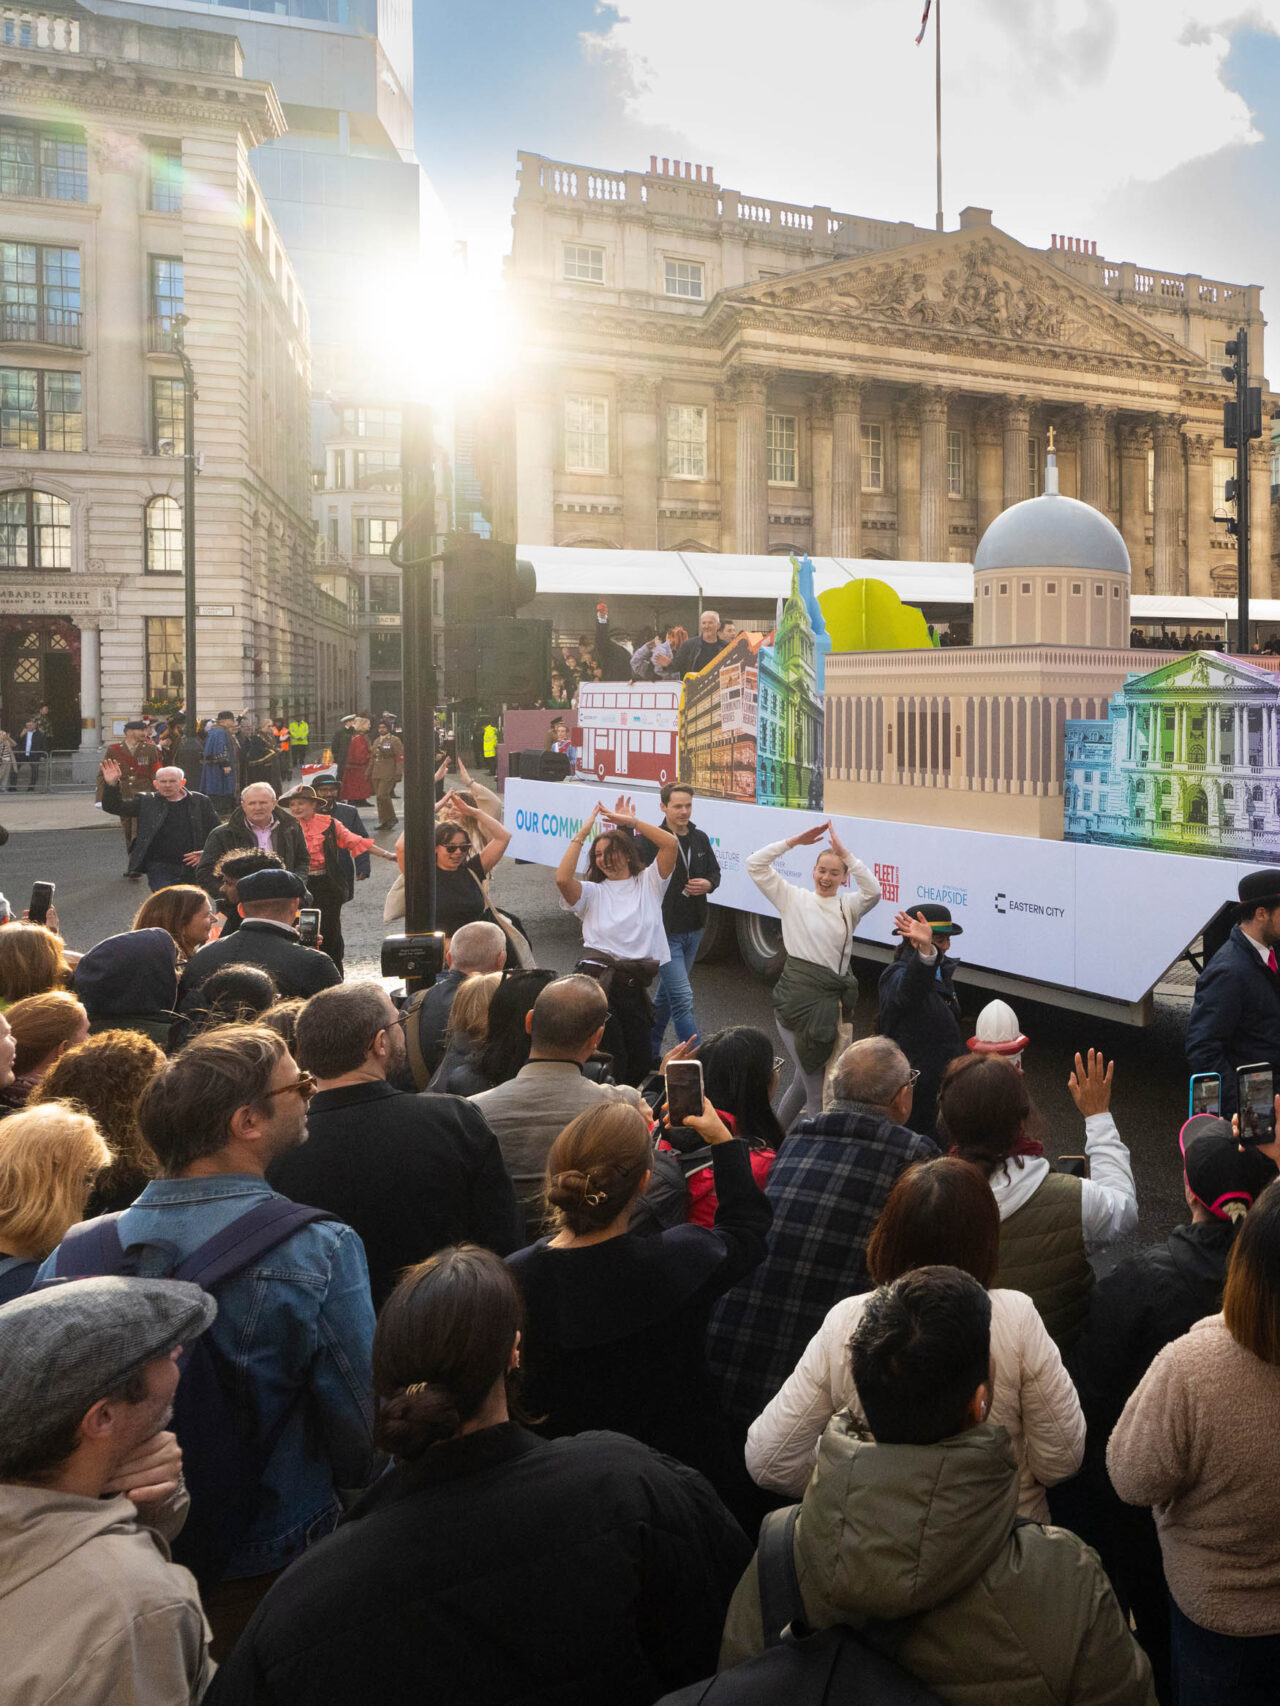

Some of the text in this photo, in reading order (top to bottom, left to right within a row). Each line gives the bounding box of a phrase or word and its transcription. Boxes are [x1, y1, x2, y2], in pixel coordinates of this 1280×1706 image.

[47, 591, 90, 599] STREET
[516, 809, 539, 834] OUR
[874, 863, 895, 883] FLEET
[916, 885, 968, 906] CHEAPSIDE
[1009, 900, 1065, 918] EASTERN CITY
